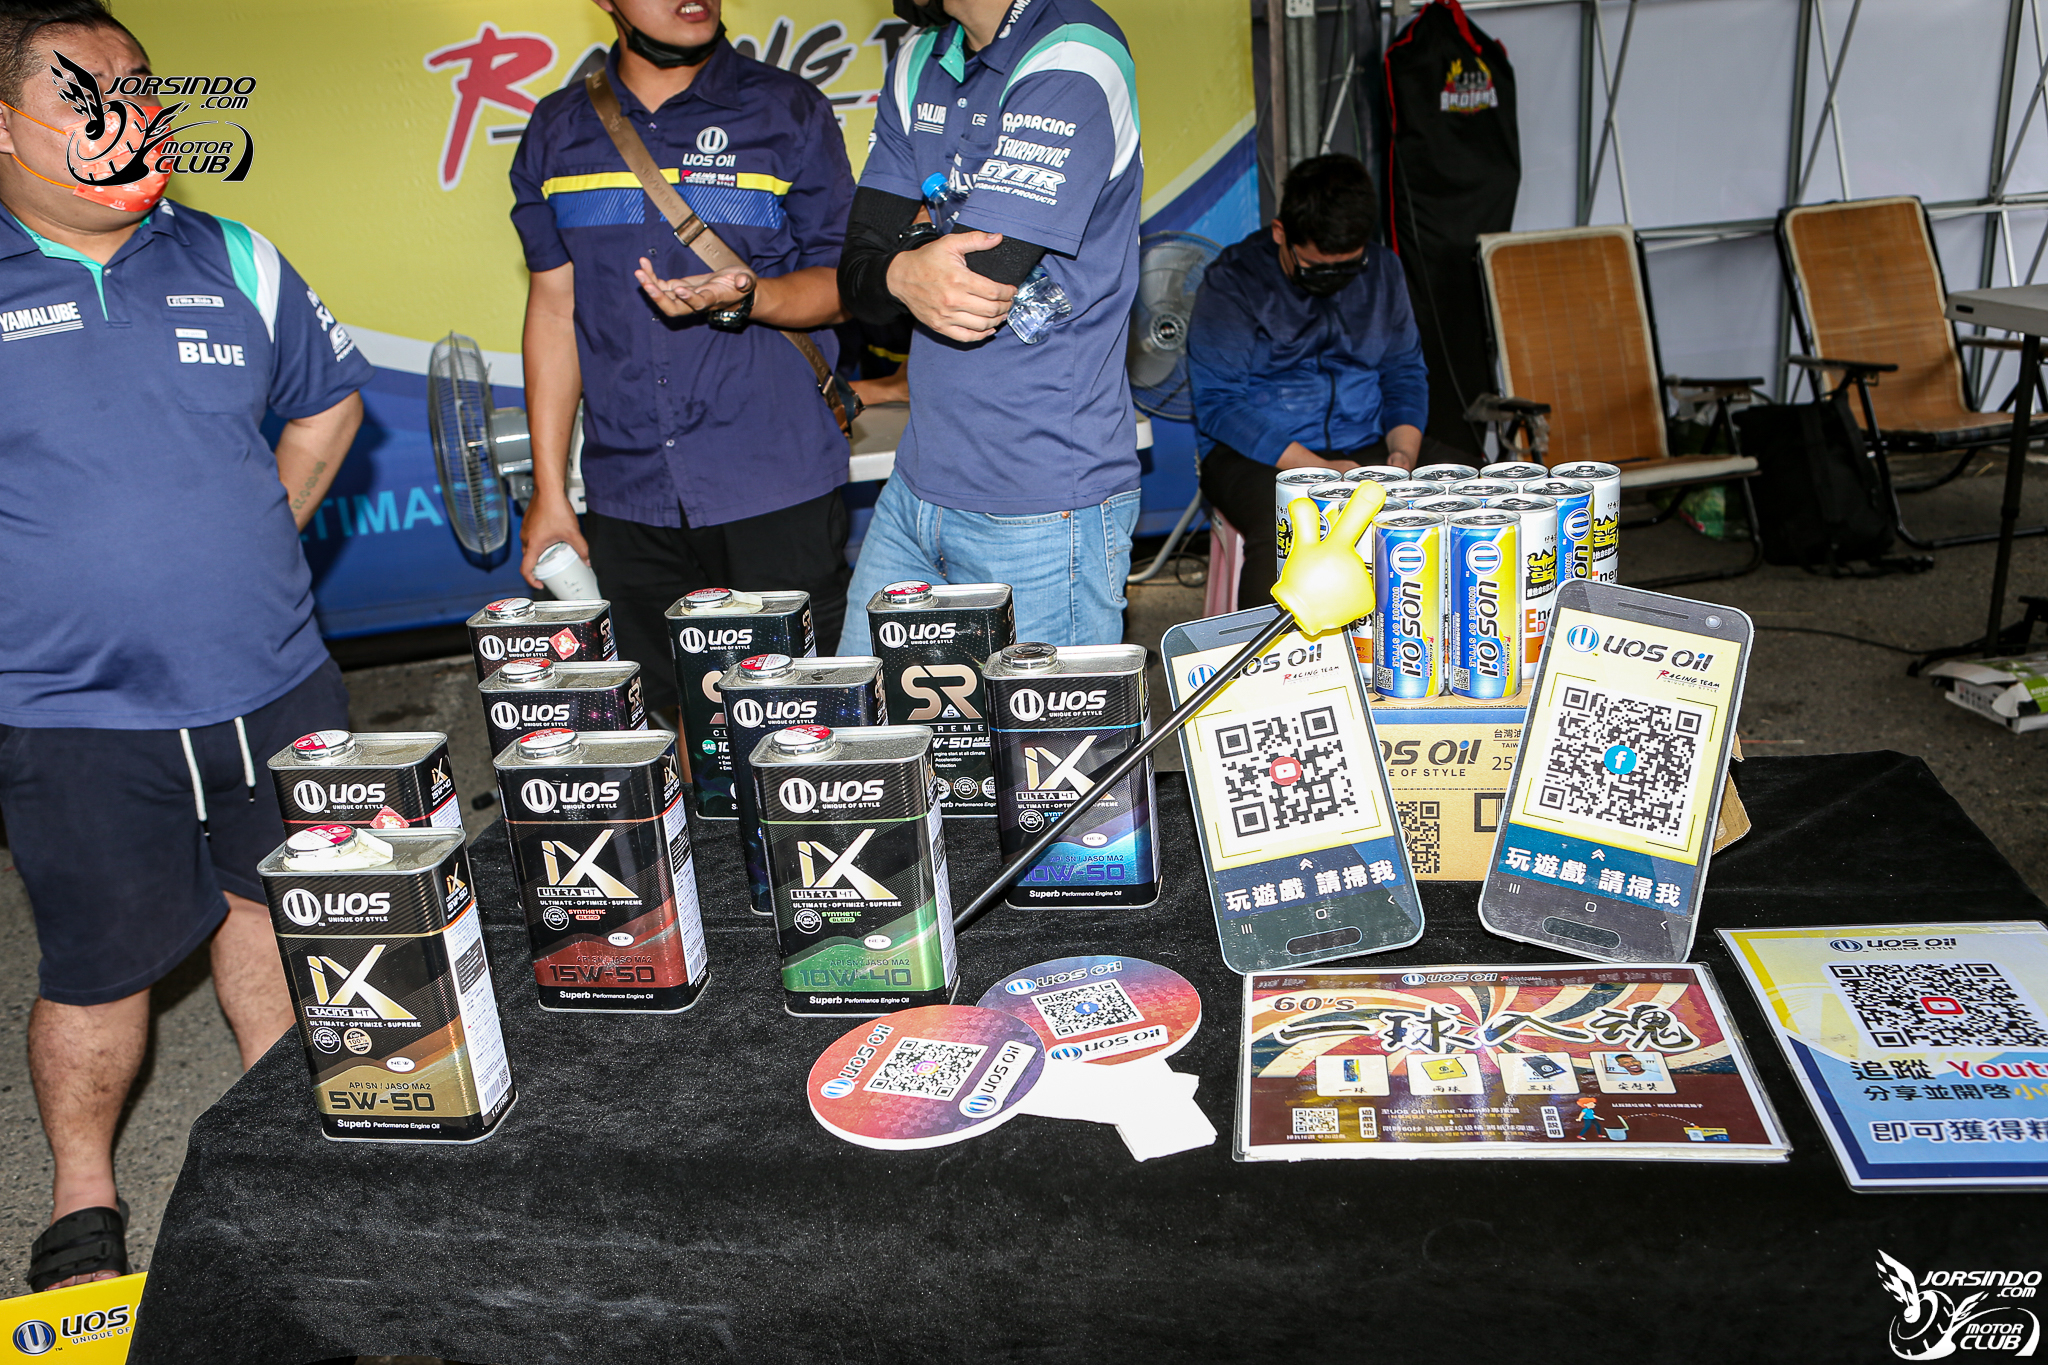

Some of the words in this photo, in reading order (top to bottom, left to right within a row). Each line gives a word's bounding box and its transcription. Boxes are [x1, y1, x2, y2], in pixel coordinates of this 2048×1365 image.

[682, 153, 715, 167] UOS
[1011, 188, 1057, 206] PRODUCTS
[0, 302, 80, 332] YAMALUBE
[178, 342, 246, 366] BLUE
[1392, 587, 1400, 620] UNIQUE
[1402, 582, 1421, 638] UOS
[1478, 581, 1498, 638] UOS
[708, 629, 753, 645] UOS
[909, 623, 956, 640] UOS
[1392, 623, 1400, 636] OF
[1469, 623, 1476, 635] OF
[507, 636, 550, 652] UOS
[1392, 638, 1400, 667] STYLE
[1602, 634, 1668, 664] UOS
[1671, 650, 1714, 672] Oil
[1287, 643, 1324, 668] Oil
[1401, 642, 1421, 676] Oil
[1478, 642, 1498, 676] Oil
[1283, 669, 1319, 685] RACING
[1320, 665, 1340, 673] TEAM
[1657, 670, 1697, 683] RACING
[901, 664, 982, 720] SR
[1047, 689, 1107, 711] UOS
[521, 703, 570, 721] UOS
[766, 701, 818, 719] UOS
[1379, 740, 1421, 765] OS
[1428, 739, 1482, 765] Oil
[329, 783, 386, 803] UOS
[559, 782, 620, 802] UOS
[819, 779, 884, 801] UOS
[1224, 876, 1306, 912] 玩遊戲
[1315, 859, 1398, 896] 請掃我
[1505, 845, 1588, 886] 玩遊戲
[1598, 867, 1682, 908] 請掃我
[324, 892, 391, 915] UOS
[1029, 890, 1060, 898] Superb
[1867, 939, 1919, 948] UOS
[1925, 937, 1957, 947] Oil
[549, 965, 655, 983] 15W-50
[799, 969, 912, 987] 10W-40
[1036, 971, 1087, 987] UOS
[1090, 961, 1123, 975] Oil
[1427, 973, 1469, 983] UOS
[1471, 972, 1498, 982] Oil
[560, 991, 590, 999] Superb
[809, 996, 842, 1005] Superb
[1274, 996, 1356, 1012] 60's
[312, 1008, 350, 1016] RACING
[1084, 1035, 1128, 1052] UOS
[1133, 1028, 1161, 1041] Oil
[839, 1041, 875, 1080] UOS
[867, 1024, 894, 1046] Oil
[984, 1066, 1009, 1094] UOS
[1002, 1045, 1021, 1065] Oil
[1850, 1060, 1936, 1081] 追蹤
[1949, 1060, 2048, 1079] Yout
[385, 1082, 409, 1090] JASO
[1339, 1086, 1367, 1094] 一球
[1527, 1083, 1556, 1092] 三球
[328, 1091, 435, 1111] 5W-50
[337, 1119, 371, 1129] Superb
[410, 1122, 430, 1130] Engine
[61, 1304, 130, 1338] UOS
[72, 1332, 113, 1344] UNIQUE
[117, 1327, 131, 1335] OF
